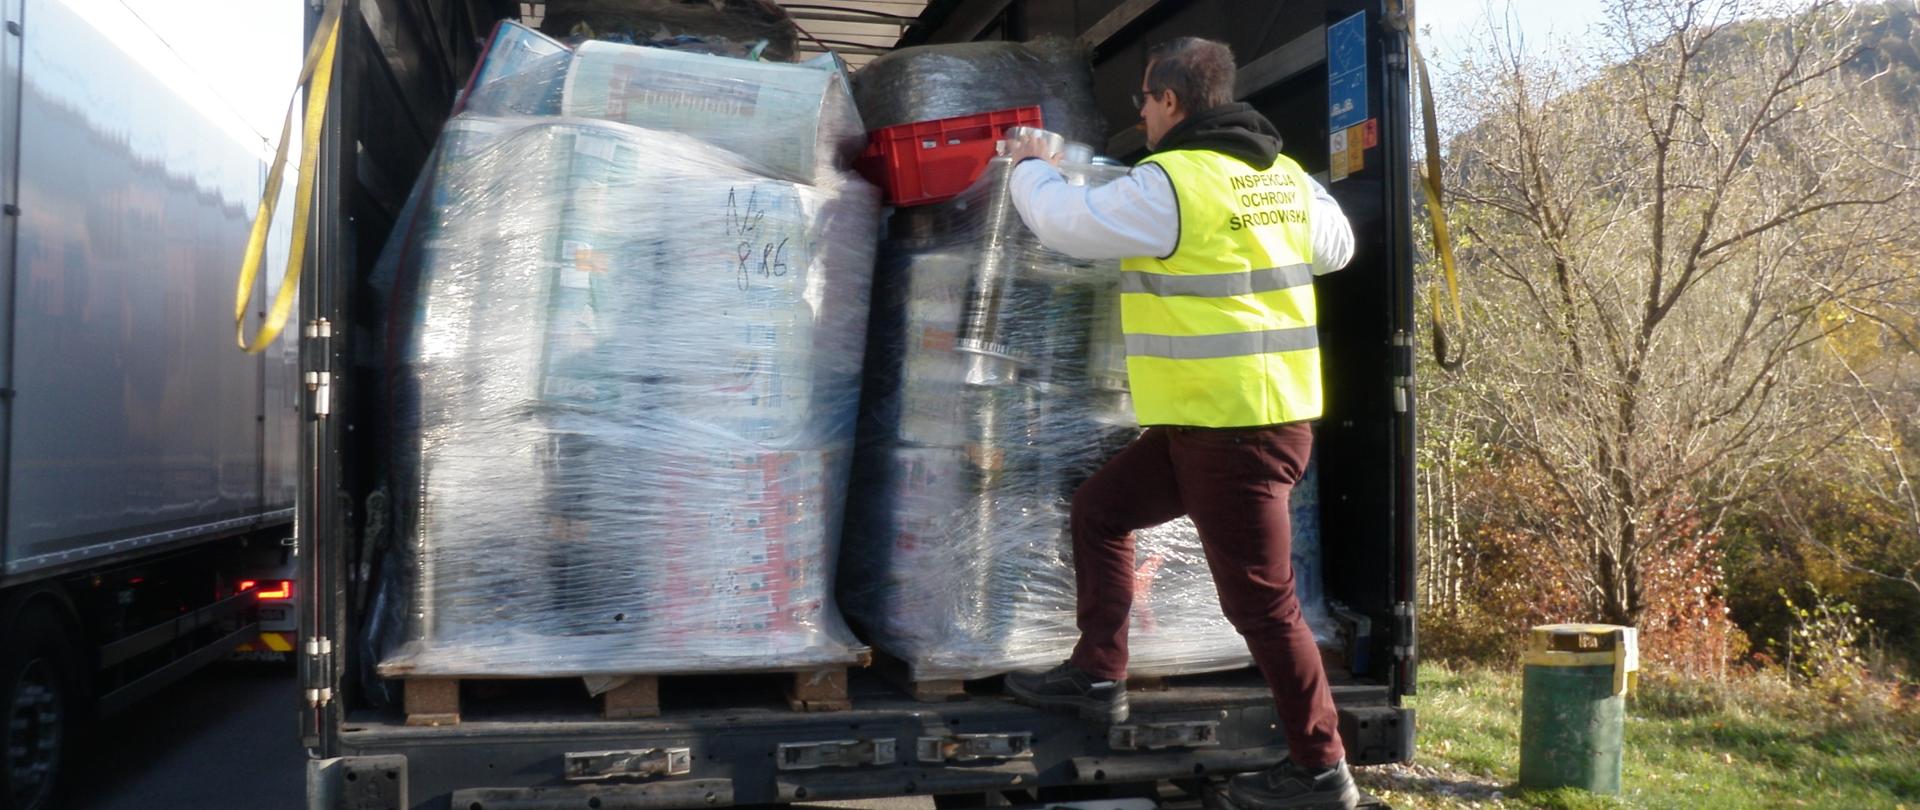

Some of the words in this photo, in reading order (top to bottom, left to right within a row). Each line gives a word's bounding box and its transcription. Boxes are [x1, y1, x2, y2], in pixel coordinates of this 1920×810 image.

[1230, 174, 1295, 190] INSPEKCJA
[1241, 192, 1296, 207] OCHRONY
[1229, 209, 1307, 231] ŚRODOWSKA
